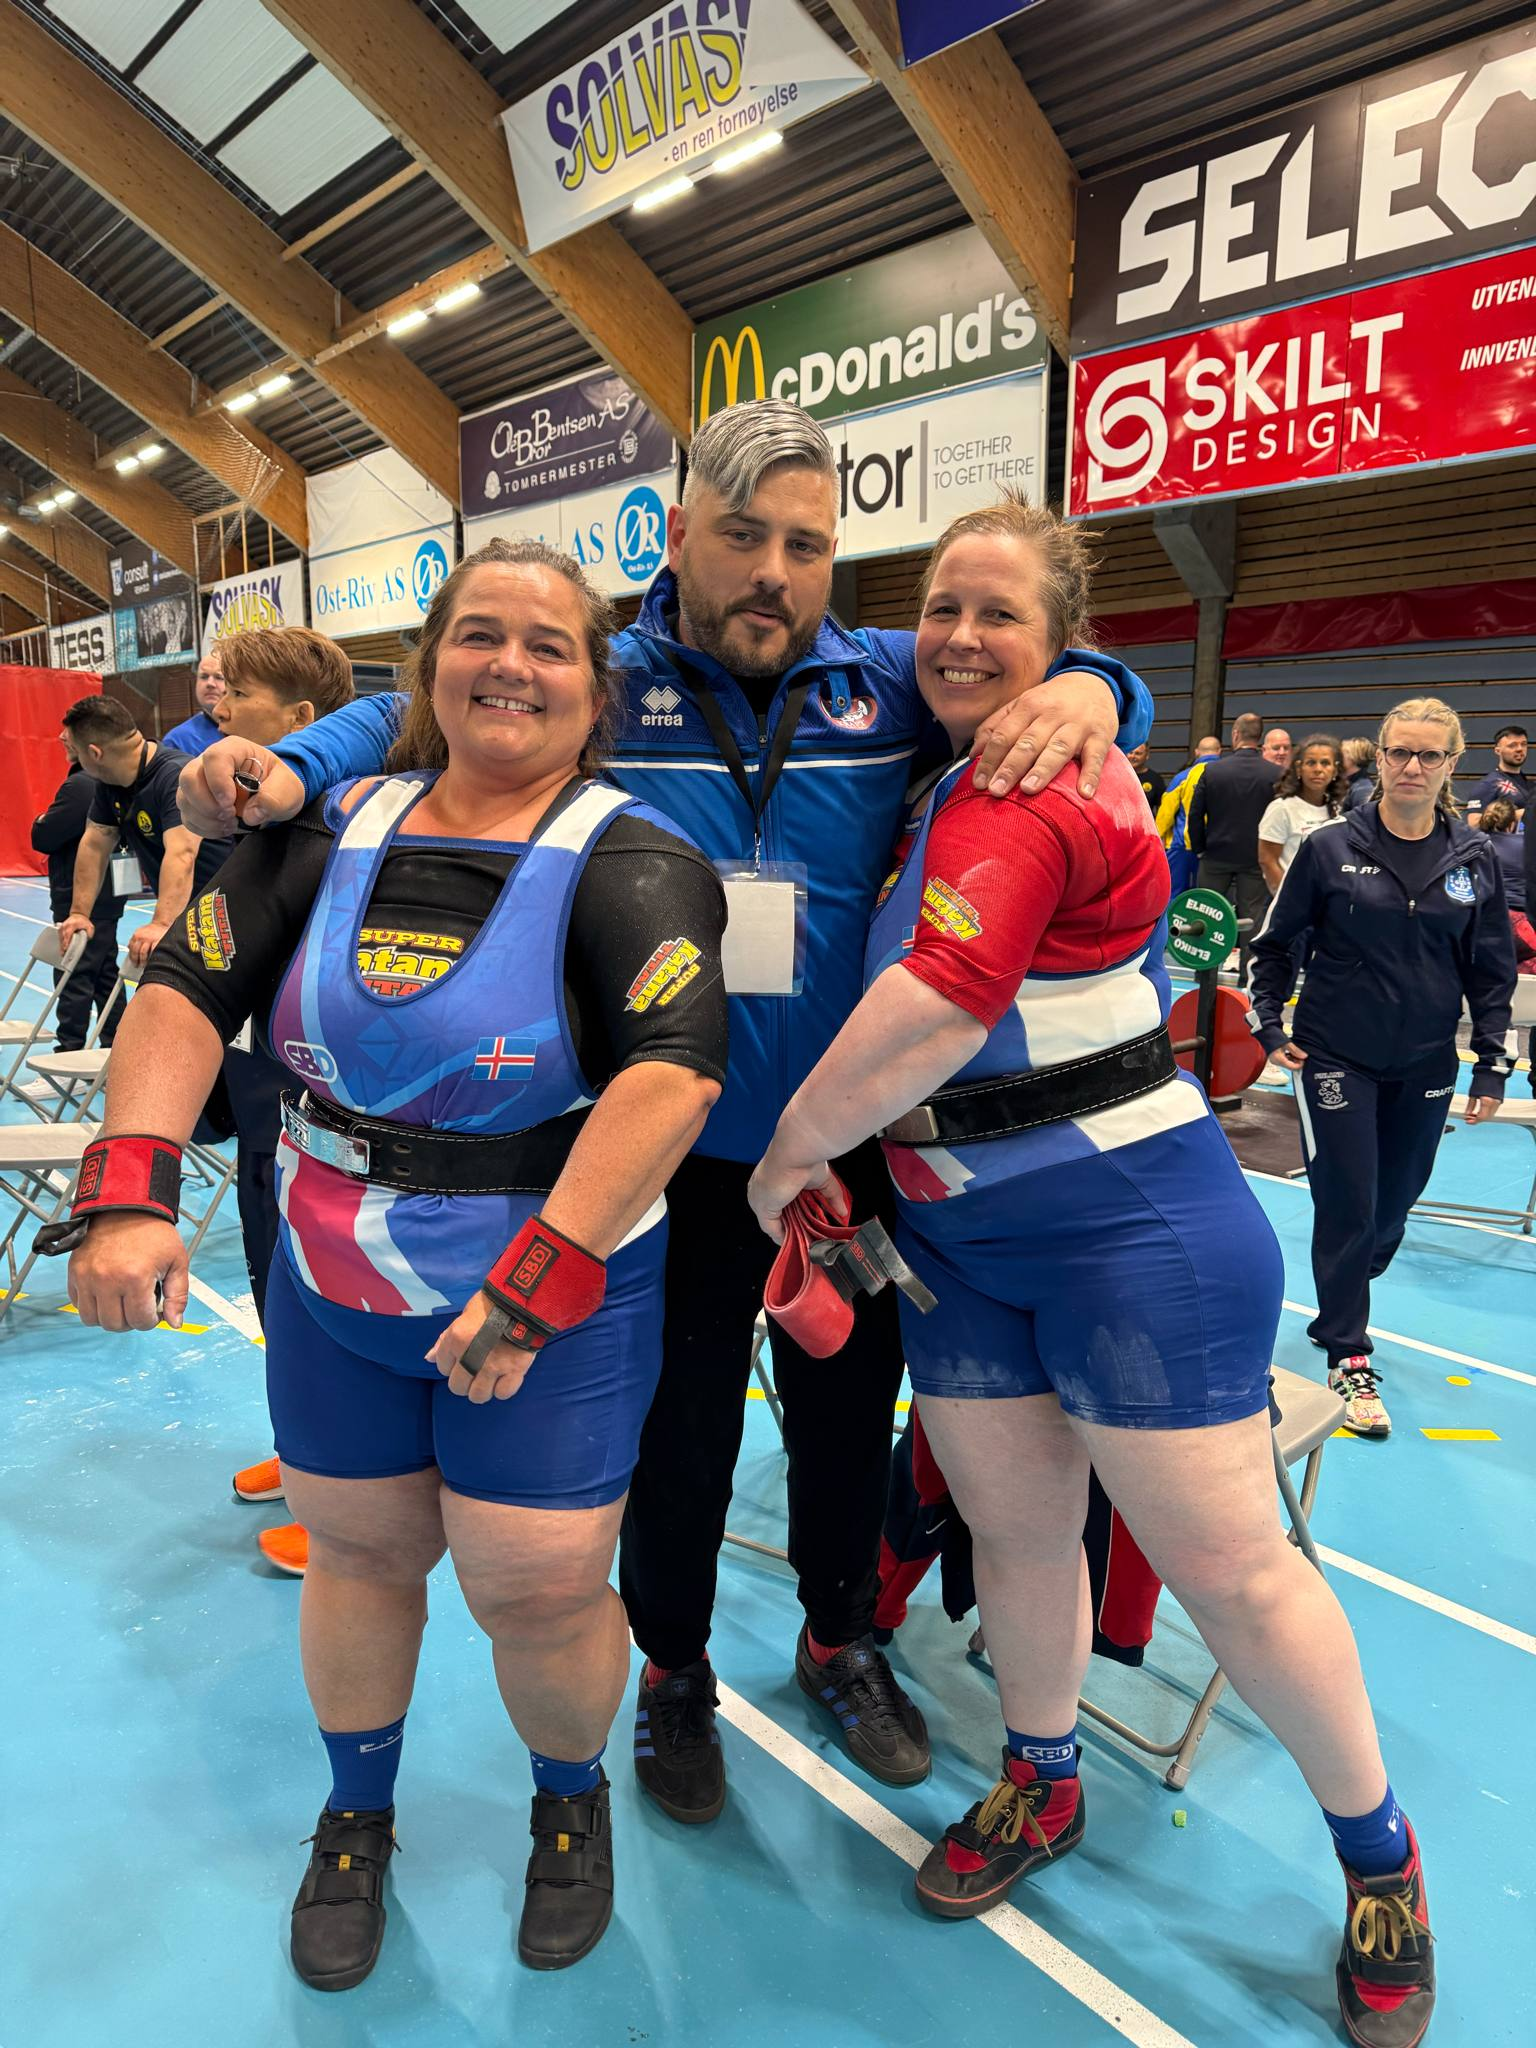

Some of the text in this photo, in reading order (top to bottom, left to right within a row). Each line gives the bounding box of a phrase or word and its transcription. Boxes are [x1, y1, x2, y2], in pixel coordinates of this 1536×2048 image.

[672, 141, 688, 162] en
[693, 127, 715, 152] ren
[718, 82, 799, 137] fornøyelse
[700, 293, 1037, 424] McDonald's
[1183, 312, 1404, 431] SKILT
[531, 408, 597, 447] Bentsen
[598, 392, 637, 429] AS
[1192, 403, 1382, 473] DESIGN
[836, 436, 1012, 519] tor TOGETHER
[933, 457, 1035, 489] TO GET THERE
[571, 522, 604, 566] AS
[381, 566, 405, 604] AS
[211, 575, 285, 639] SOLVASK
[53, 626, 105, 669] TESS
[641, 713, 683, 727] errea
[187, 907, 201, 953] SUPER
[1185, 898, 1224, 922] ELEIKO
[199, 892, 225, 969] Katana
[358, 928, 464, 954] SUPER
[1173, 938, 1211, 962] ELEIKO
[1212, 931, 1225, 942] 10
[357, 946, 453, 979] atan
[632, 938, 700, 1012] Katana
[81, 1156, 99, 1196] SBD
[517, 1246, 548, 1286] SBD
[851, 1242, 864, 1261] SBD
[513, 1321, 528, 1339] SB
[1025, 1744, 1072, 1762] SBD
